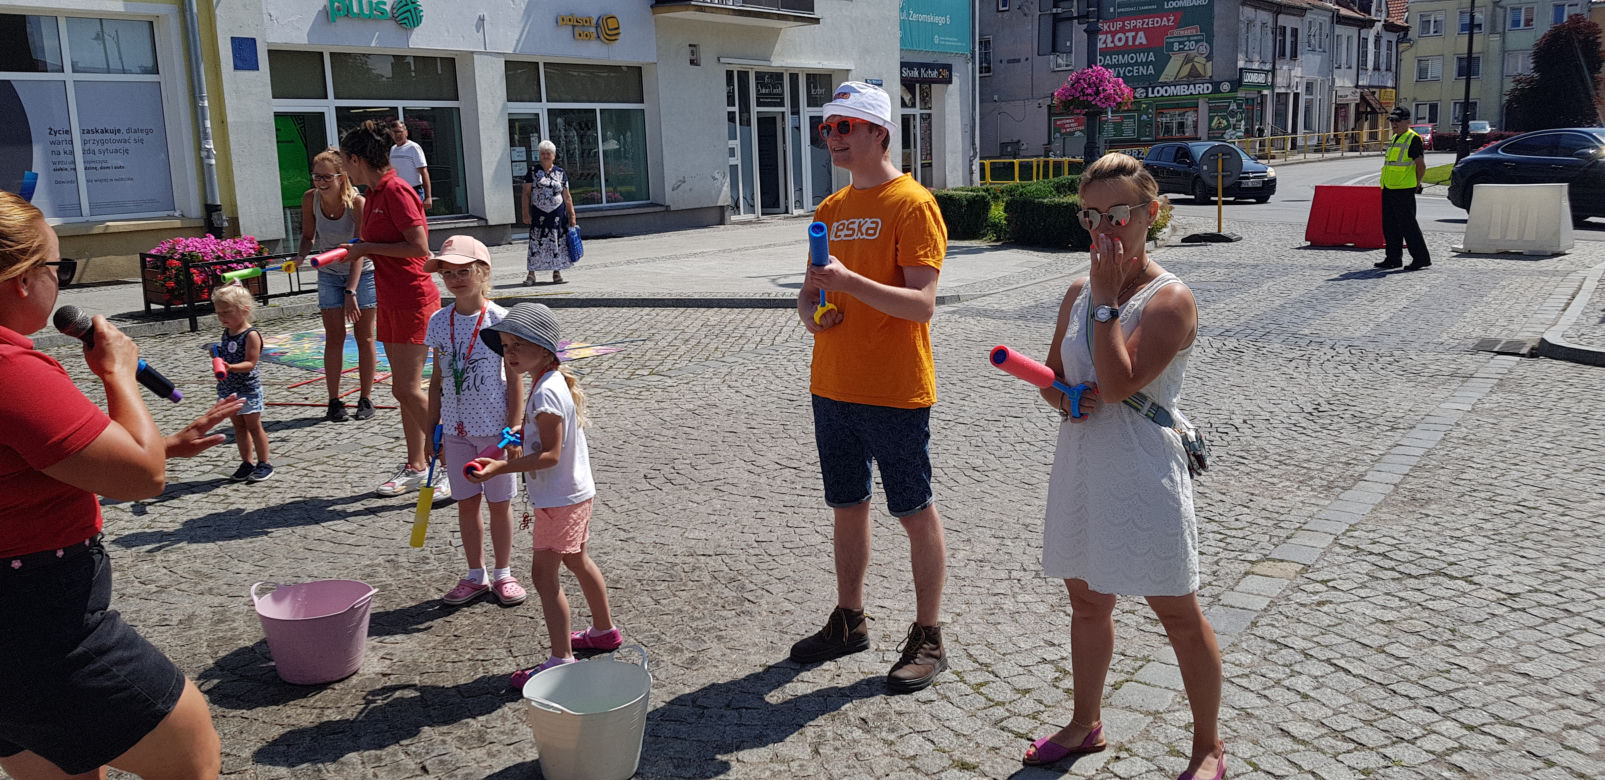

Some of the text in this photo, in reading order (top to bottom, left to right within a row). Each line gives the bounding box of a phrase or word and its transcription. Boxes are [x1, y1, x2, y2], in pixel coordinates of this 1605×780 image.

[329, 0, 389, 22] plus
[1164, 0, 1208, 9] LOOMBARD
[558, 14, 594, 27] polsat
[909, 8, 946, 25] Żeromskiego
[1099, 14, 1175, 32] SKUP SPRZEDAŻ
[576, 29, 596, 40] box
[1098, 31, 1147, 49] ZŁOTA
[1173, 41, 1196, 51] 8-20
[1098, 52, 1155, 66] DARMOWA
[1244, 72, 1266, 84] LOOMBARD
[1148, 83, 1213, 98] LOOMBARD
[48, 127, 154, 137] Życie zaskakuje, dlatego
[49, 137, 145, 147] warto przygotować się
[98, 147, 130, 156] sytuację
[832, 217, 882, 241] eska
